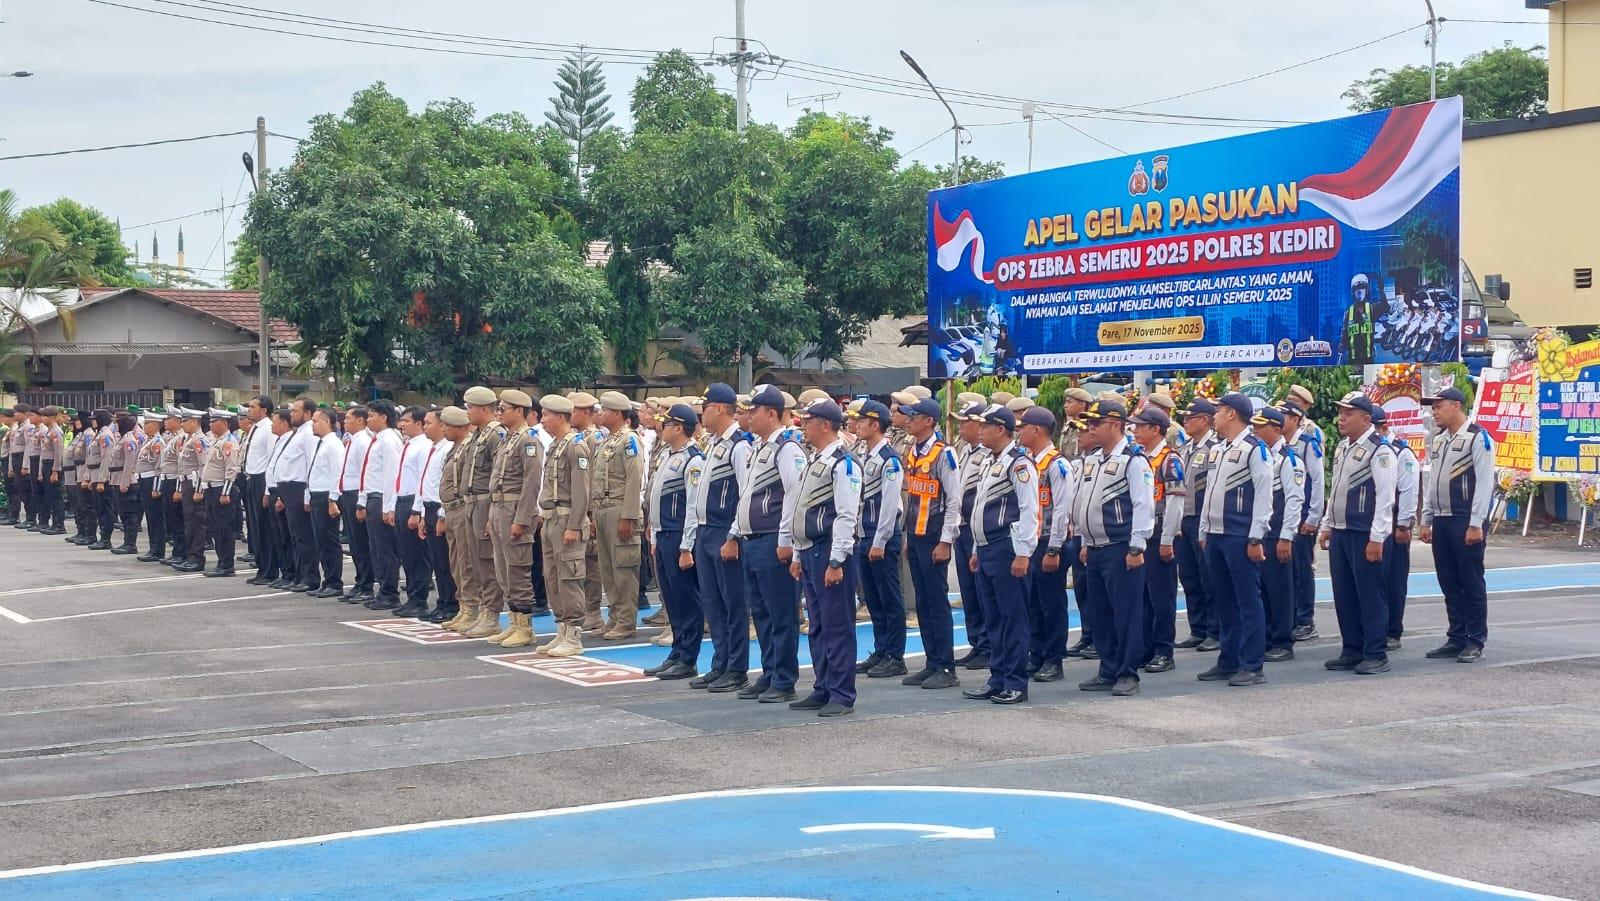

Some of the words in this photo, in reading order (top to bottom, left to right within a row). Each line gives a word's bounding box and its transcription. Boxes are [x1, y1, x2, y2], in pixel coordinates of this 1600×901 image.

[1024, 213, 1078, 247] APEL
[1084, 201, 1162, 238] GELAR
[1169, 181, 1298, 227] PASUKAN
[997, 260, 1026, 282] OPS
[1029, 254, 1076, 279] ZEBRA
[1079, 246, 1142, 273] SEMERU
[1145, 241, 1189, 267] 2025
[1193, 232, 1264, 261] POLRES
[1269, 224, 1335, 254] KEDIRI
[1010, 295, 1038, 307] DALAM
[1038, 292, 1072, 304] RANGKA
[1074, 287, 1137, 301] TERWUJUDNYA
[1139, 275, 1247, 296] KAMSELTIBCARLANTAS
[1248, 272, 1278, 287] YANG
[1279, 269, 1314, 285] AMAN,
[1025, 306, 1060, 319] NYAMAN
[1060, 304, 1078, 316] DAN
[1078, 301, 1119, 315] SELAMAT
[1119, 297, 1175, 312] MENJELANG
[1175, 294, 1195, 307] OPS
[1196, 292, 1222, 306] LILIN
[1223, 290, 1265, 304] SEMERU
[1266, 288, 1293, 302] 2025
[1101, 329, 1121, 341] Pare,
[1123, 328, 1132, 338] 17
[1133, 325, 1176, 338] November
[1177, 323, 1200, 335] 2025
[1093, 354, 1134, 363] BERBUAT
[1148, 352, 1191, 362] ADAPTIF
